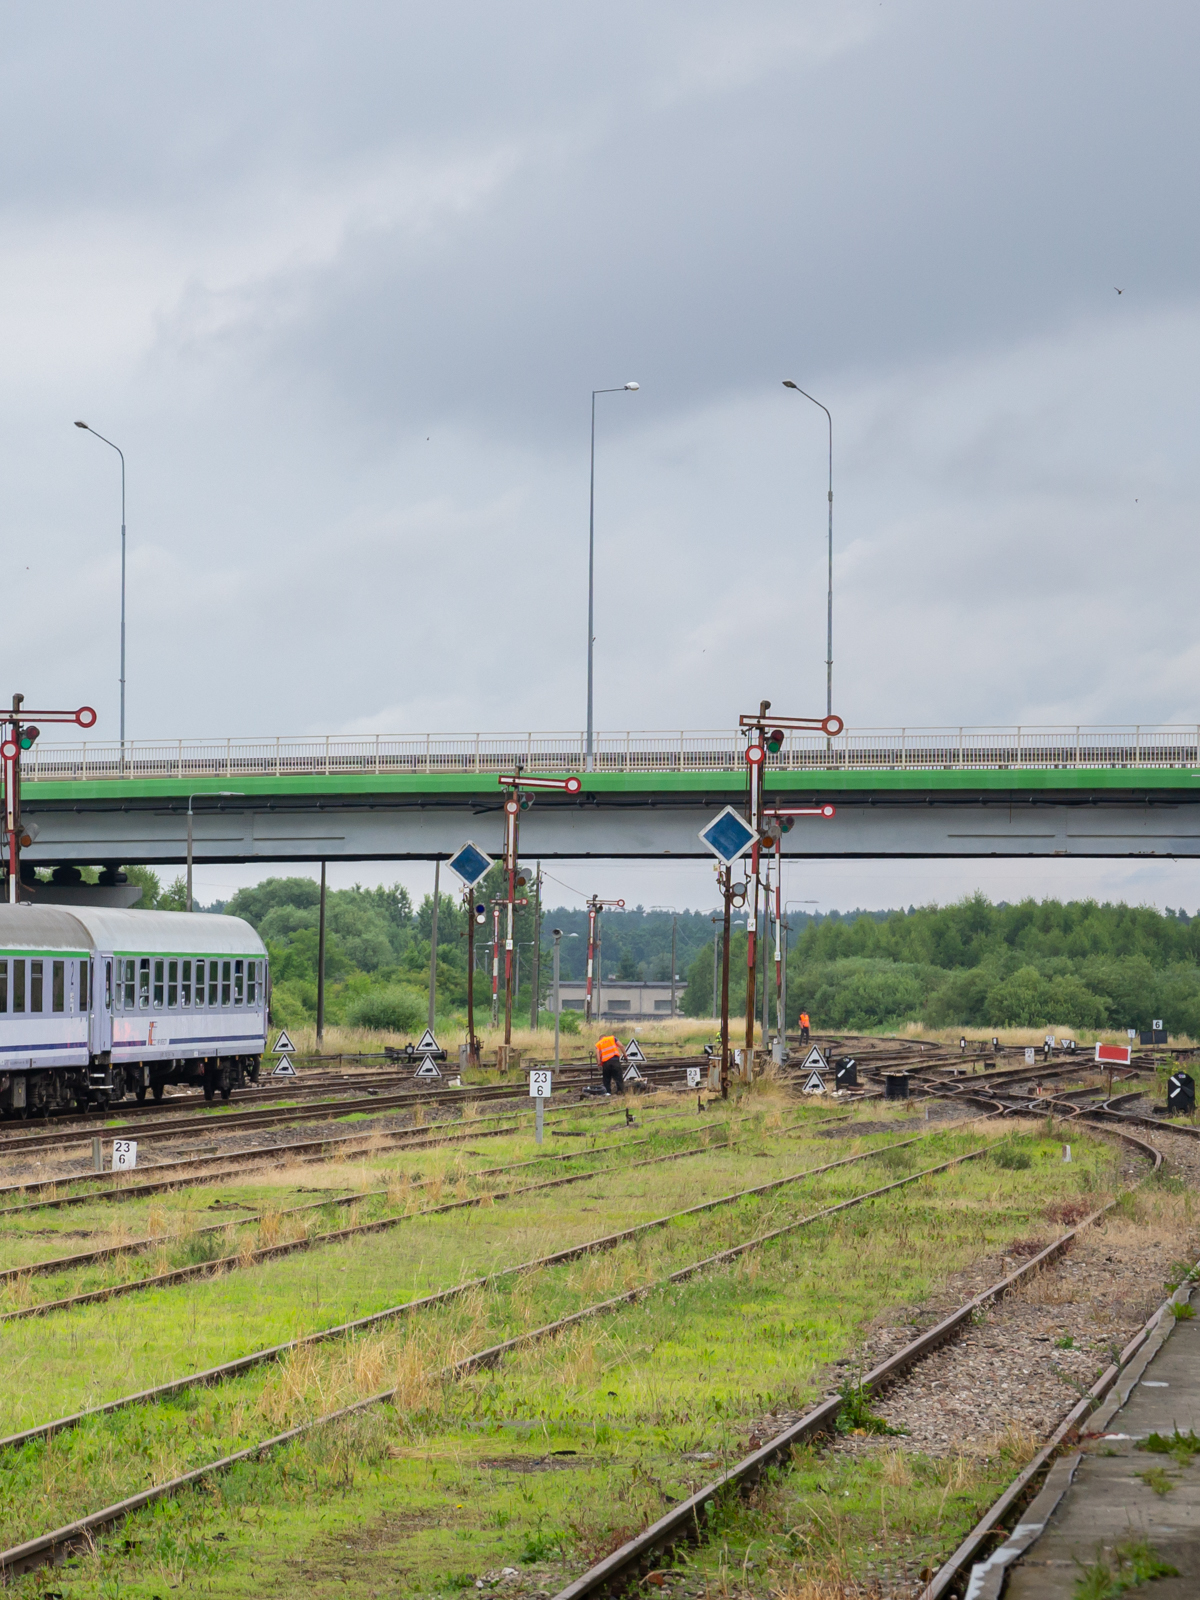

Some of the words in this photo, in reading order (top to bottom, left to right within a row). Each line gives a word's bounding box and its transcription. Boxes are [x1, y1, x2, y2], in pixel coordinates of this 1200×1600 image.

[1155, 1021, 1161, 1029] 6
[534, 1072, 548, 1083] 23
[537, 1085, 544, 1096] 6
[115, 1141, 130, 1153] 23
[118, 1154, 126, 1164] 6
